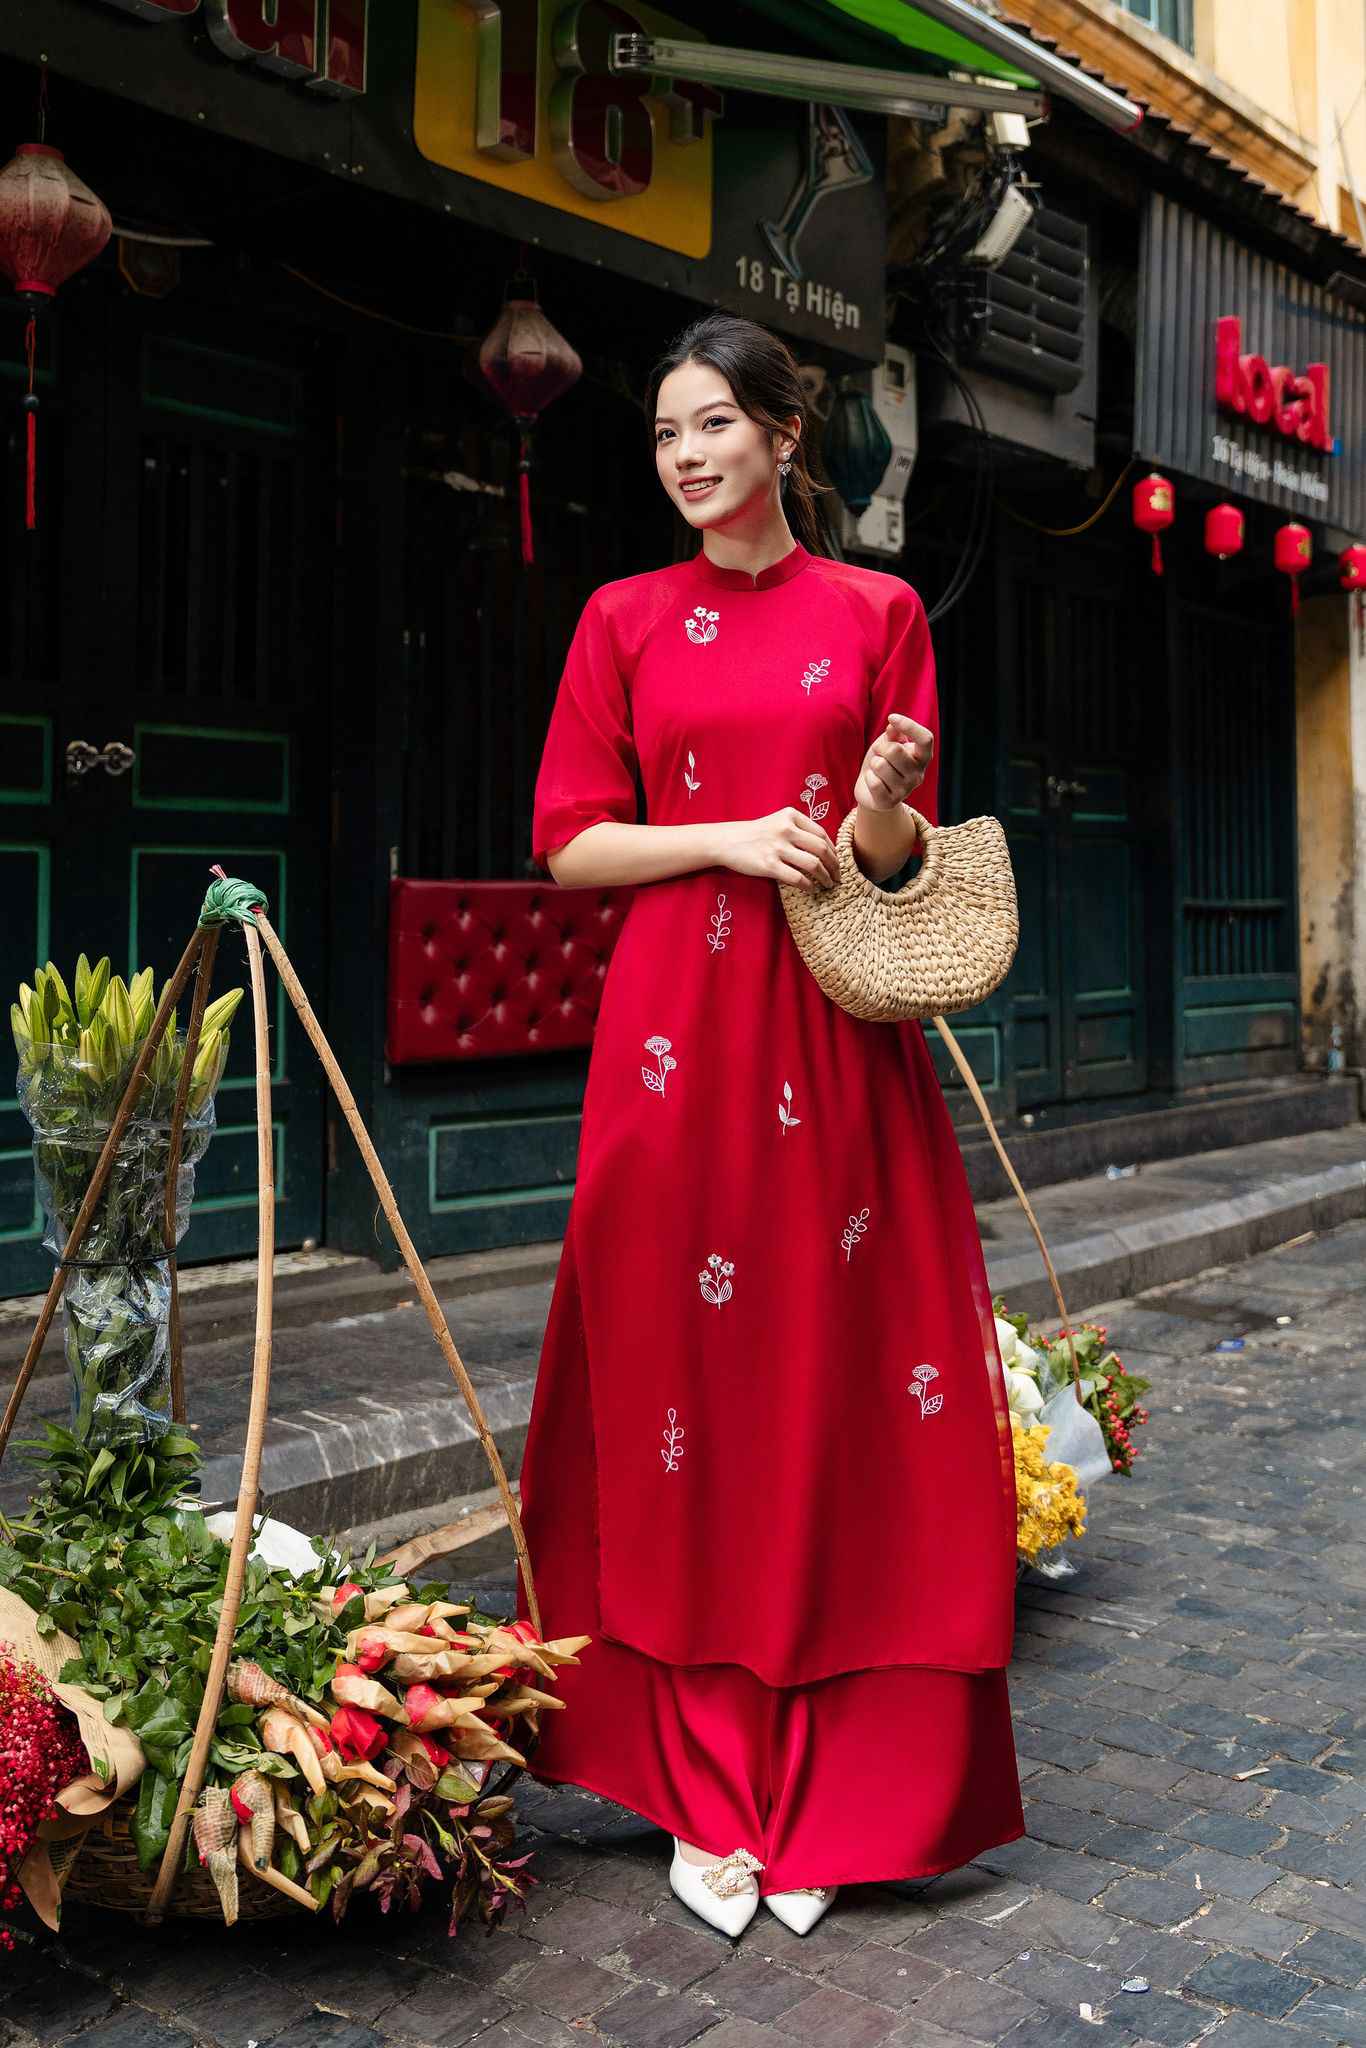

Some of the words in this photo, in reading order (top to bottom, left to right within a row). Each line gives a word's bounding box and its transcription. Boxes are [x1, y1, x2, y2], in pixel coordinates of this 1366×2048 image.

[735, 256, 763, 294] 18
[770, 266, 800, 314] Tạ
[806, 280, 860, 330] Hiện
